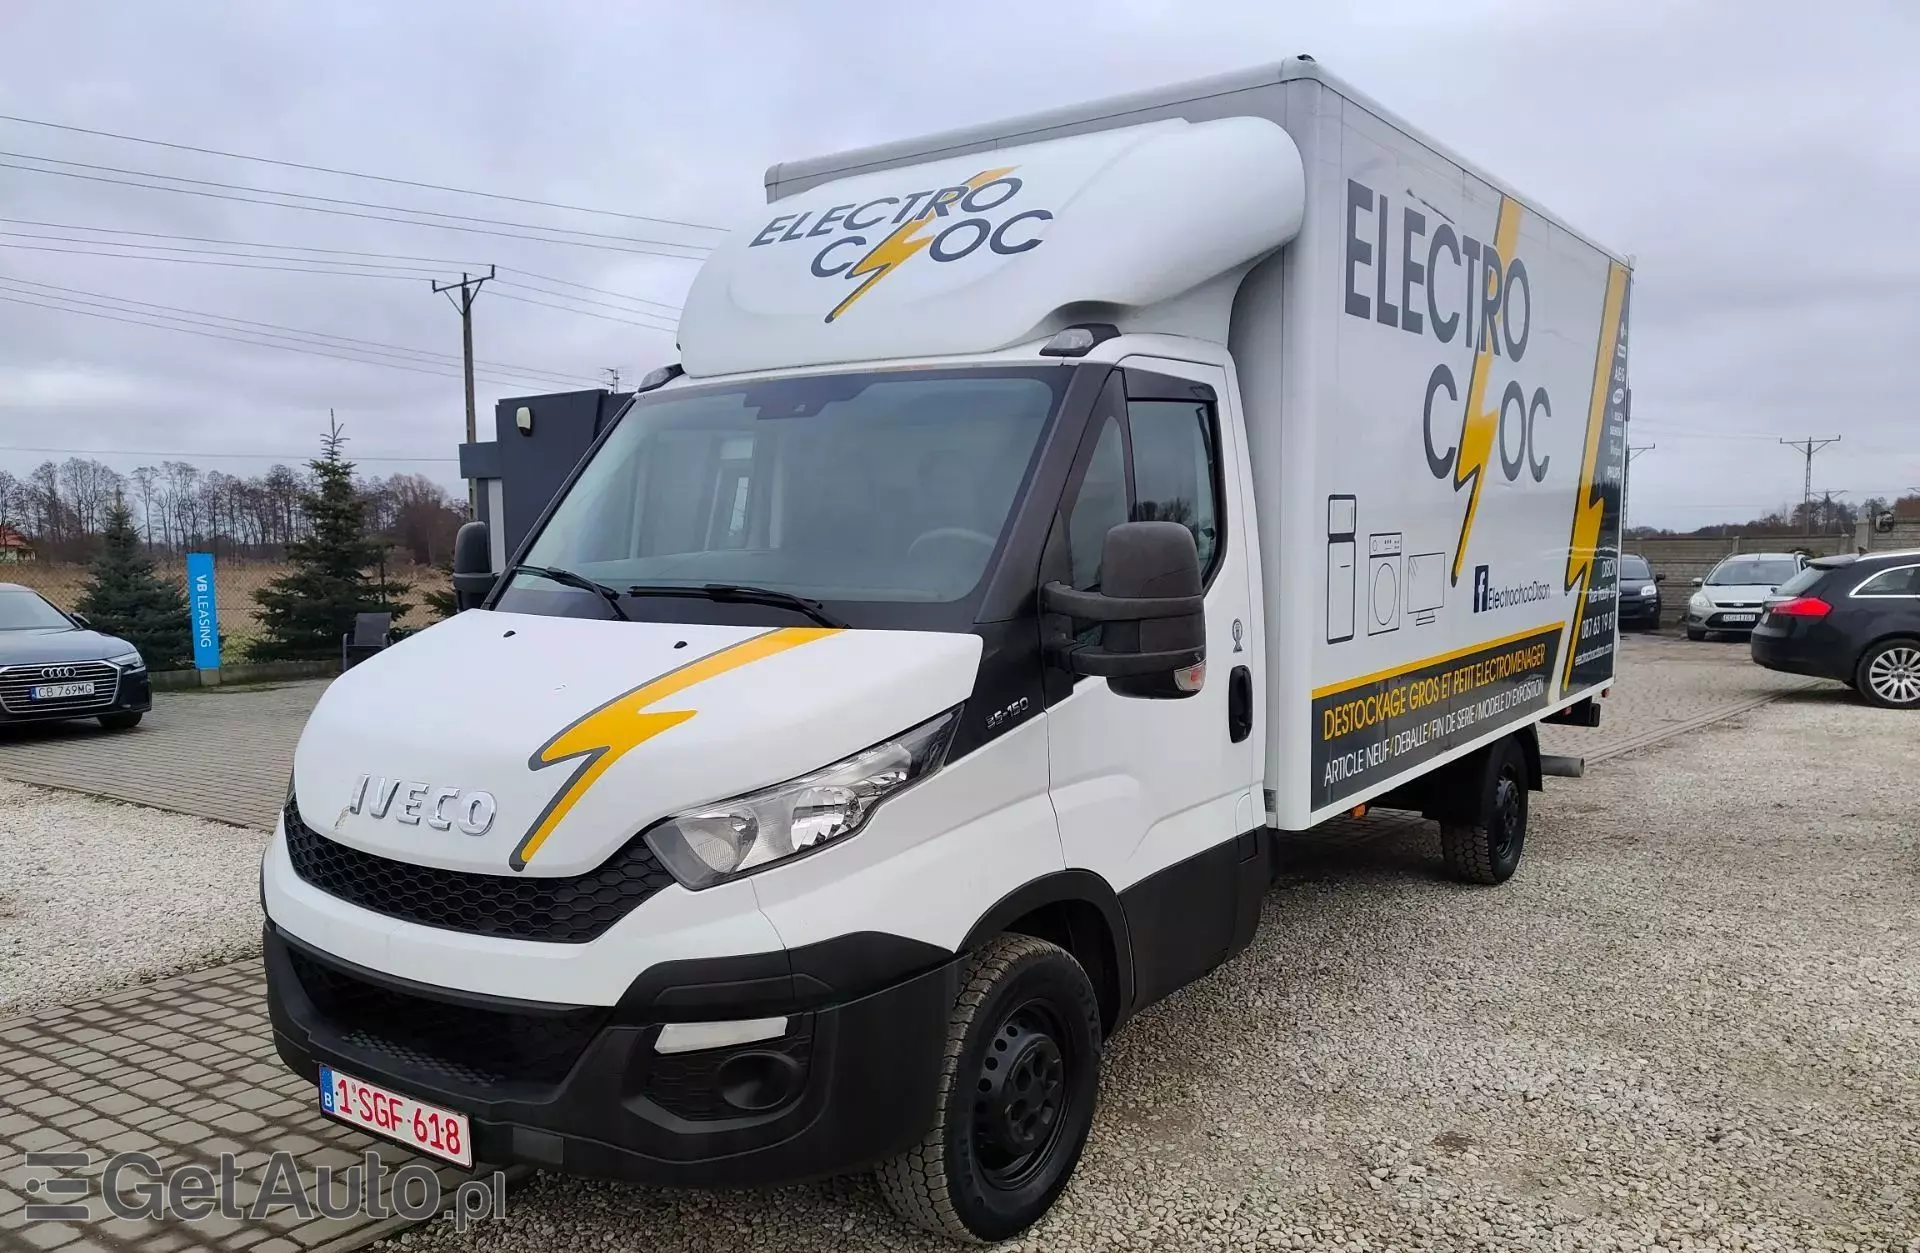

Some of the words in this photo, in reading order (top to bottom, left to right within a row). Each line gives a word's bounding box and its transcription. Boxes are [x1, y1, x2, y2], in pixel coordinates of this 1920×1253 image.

[748, 177, 1023, 248] ELECTRO
[1345, 178, 1531, 362] ELECTRO
[196, 574, 208, 592] VB
[197, 595, 212, 647] LEASING
[39, 687, 53, 697] CB
[58, 684, 92, 696] 769MG
[1324, 687, 1407, 741] DESTOCKAGE
[1409, 676, 1439, 710] GROS
[1441, 672, 1453, 699] ET
[1453, 664, 1475, 695] PETIT
[1476, 643, 1546, 687] ELECTROMENAGER
[1323, 749, 1364, 787] ARTICLE
[1445, 712, 1456, 734] DE
[350, 773, 497, 836] IVECO
[324, 1092, 333, 1108] B
